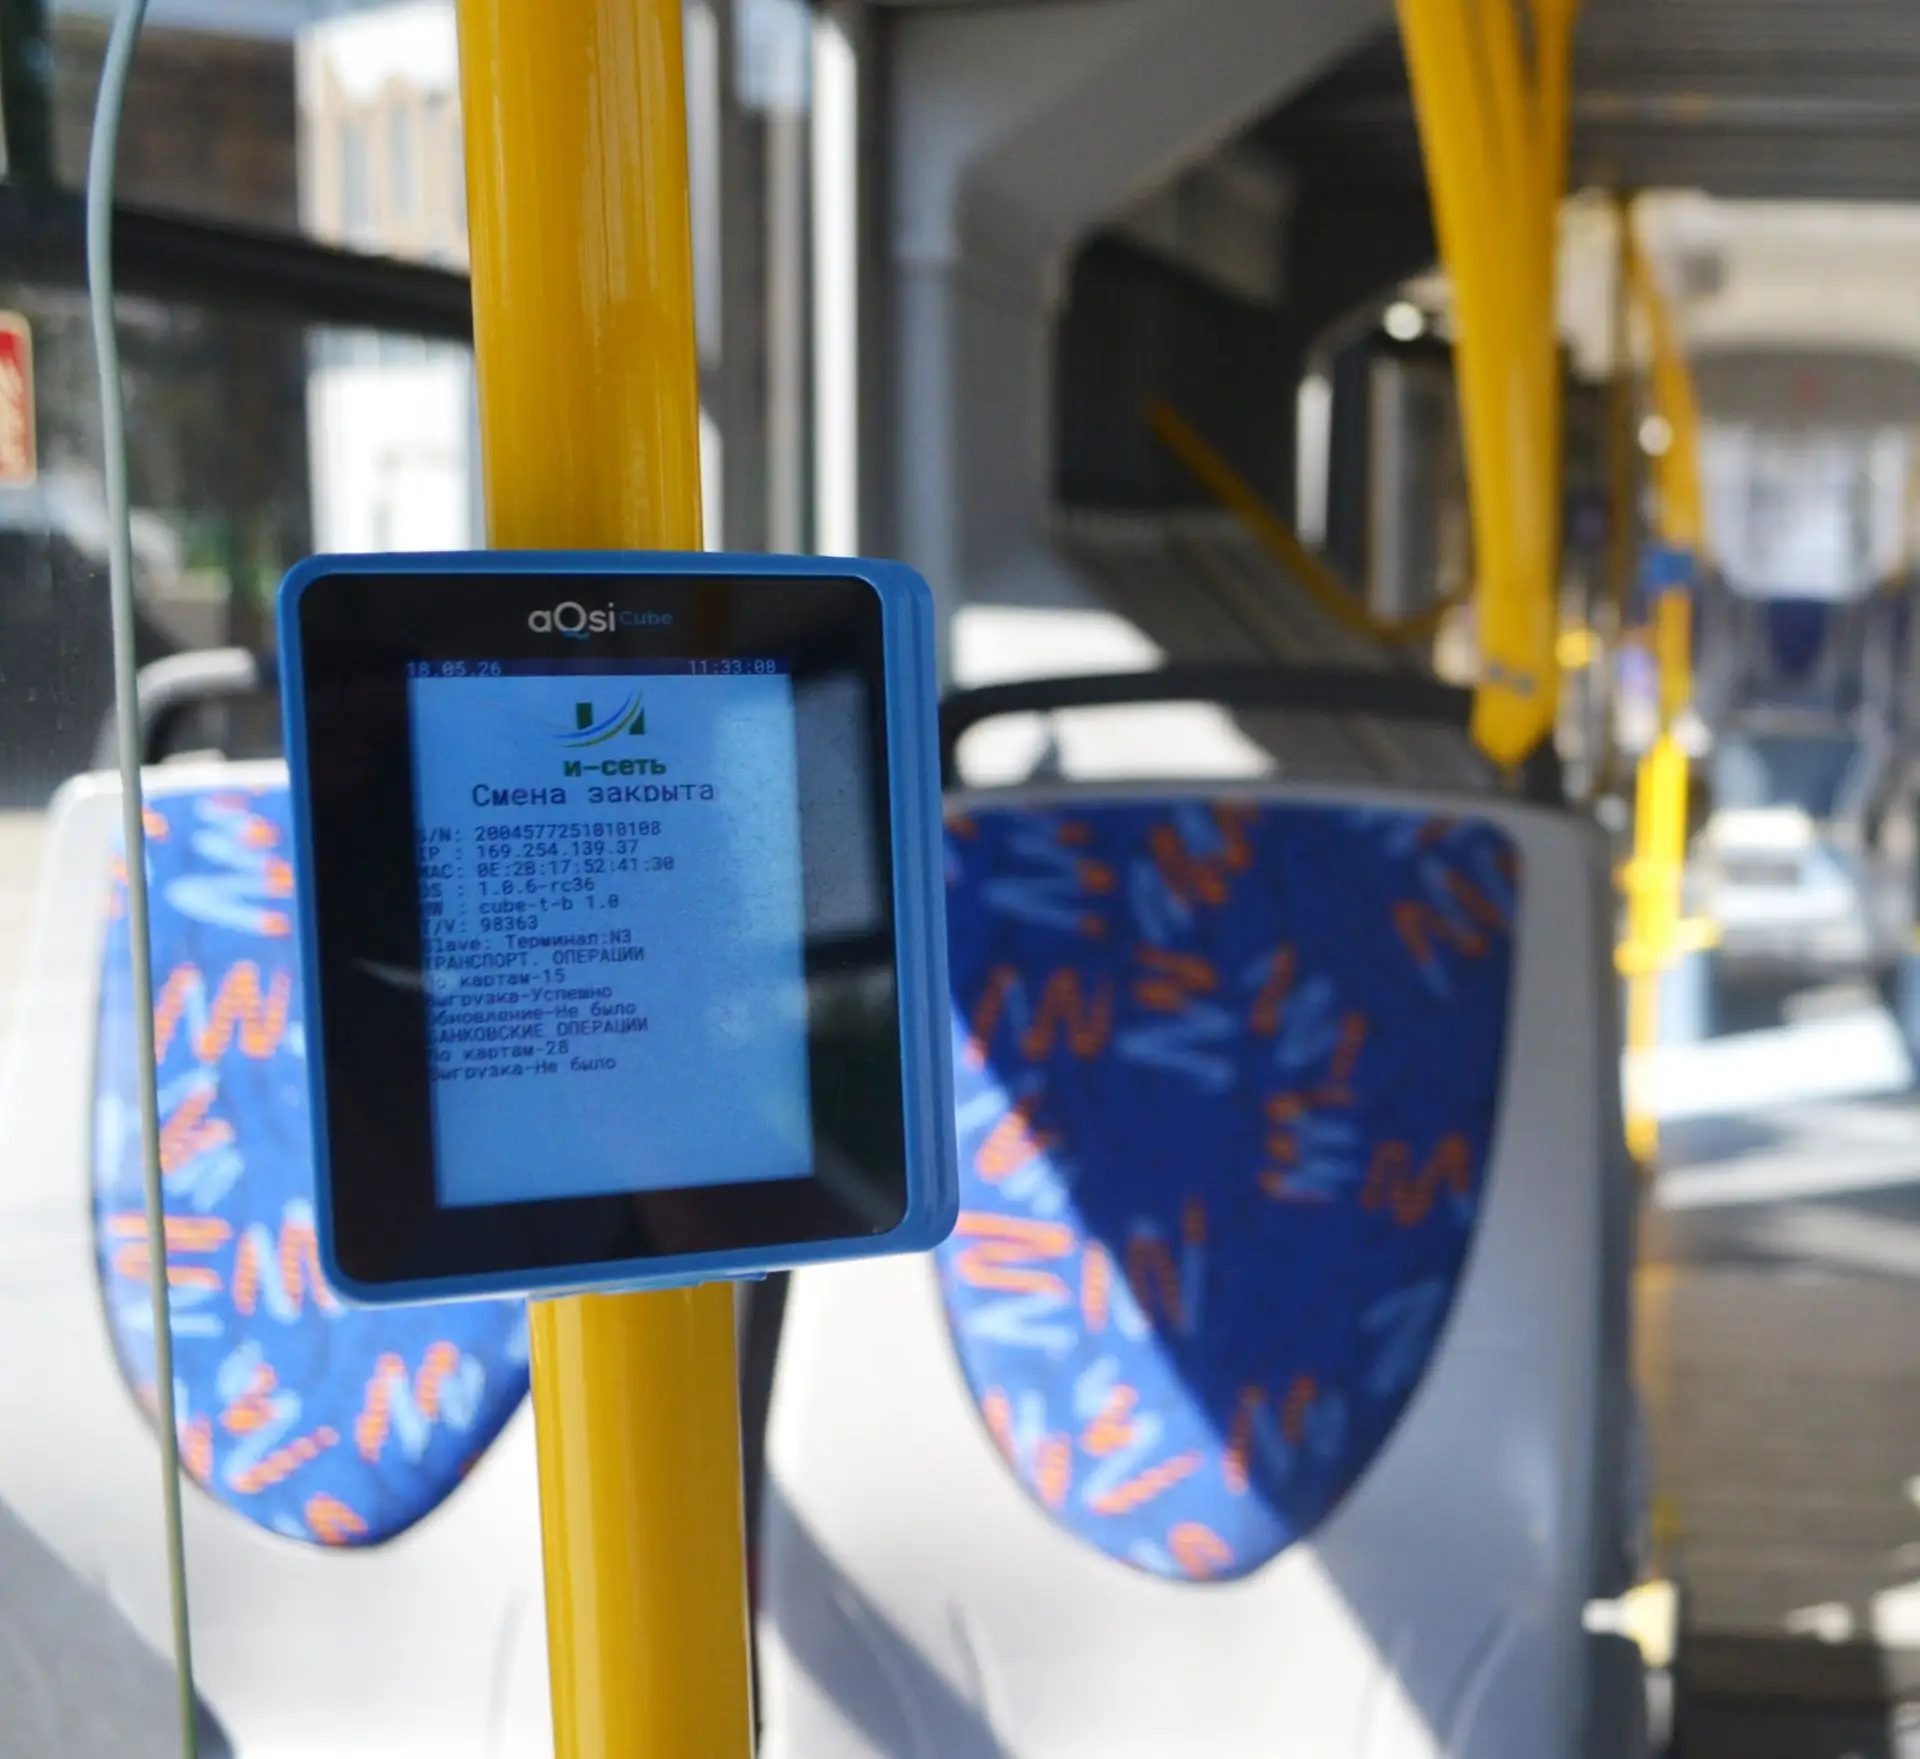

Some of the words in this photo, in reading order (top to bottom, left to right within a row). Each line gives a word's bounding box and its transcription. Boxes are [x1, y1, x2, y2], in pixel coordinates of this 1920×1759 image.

[528, 601, 616, 639] aQsi
[619, 609, 673, 626] Cube
[406, 659, 502, 676] 18.05.26
[687, 658, 776, 674] 11:33:08
[471, 784, 567, 807] Смена
[587, 781, 715, 803] закрыта
[477, 840, 639, 859] 169.254.139.37
[480, 916, 539, 932] 98363
[552, 947, 645, 965] ОПЕРАЦИИ
